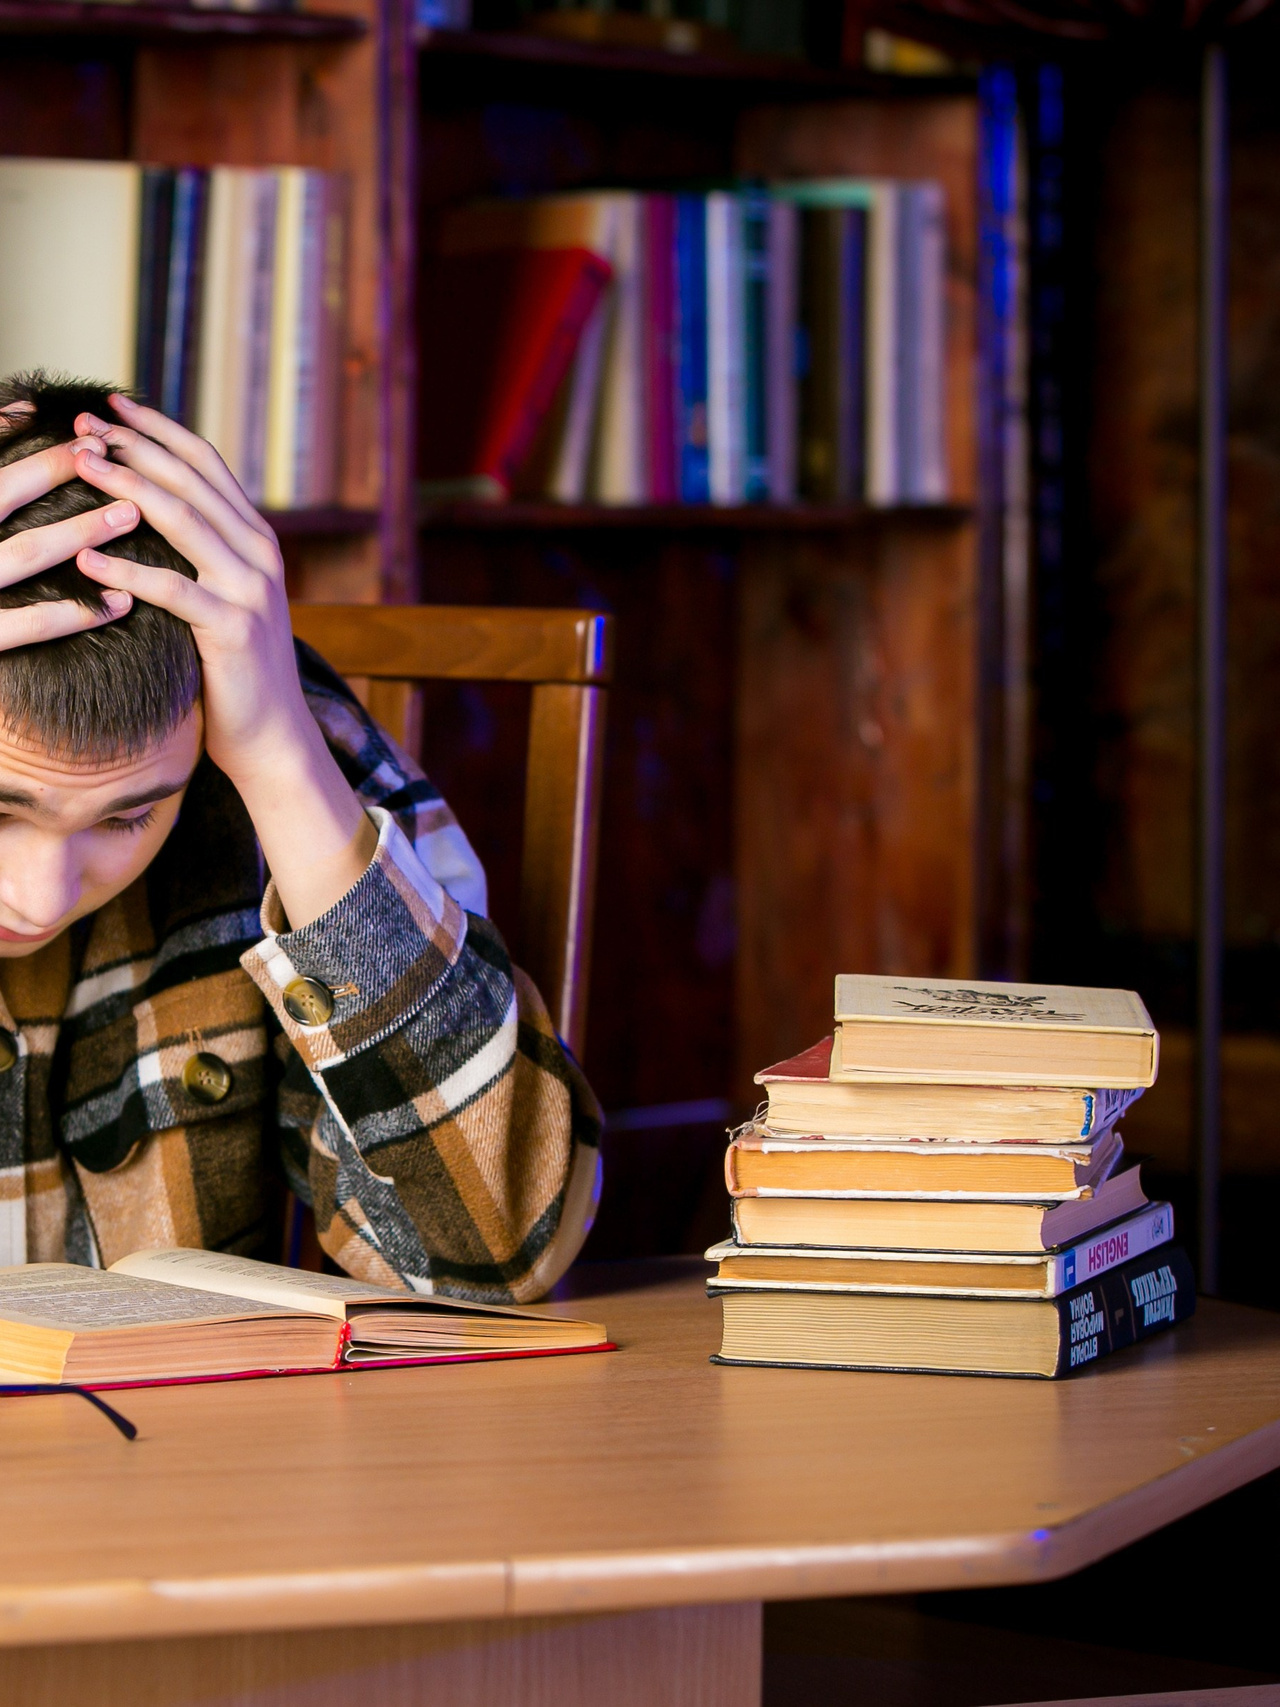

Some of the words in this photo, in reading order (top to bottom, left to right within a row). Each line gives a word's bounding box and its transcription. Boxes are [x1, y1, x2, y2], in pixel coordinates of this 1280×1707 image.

[1088, 1231, 1129, 1272] ENGLISH
[1131, 1265, 1178, 1307] ЧЕРЧИЛЛЬ
[1069, 1291, 1095, 1320] ВОЙНА
[1070, 1310, 1104, 1344] МИРОВАЯ
[1070, 1336, 1098, 1367] ВТОРАЯ
